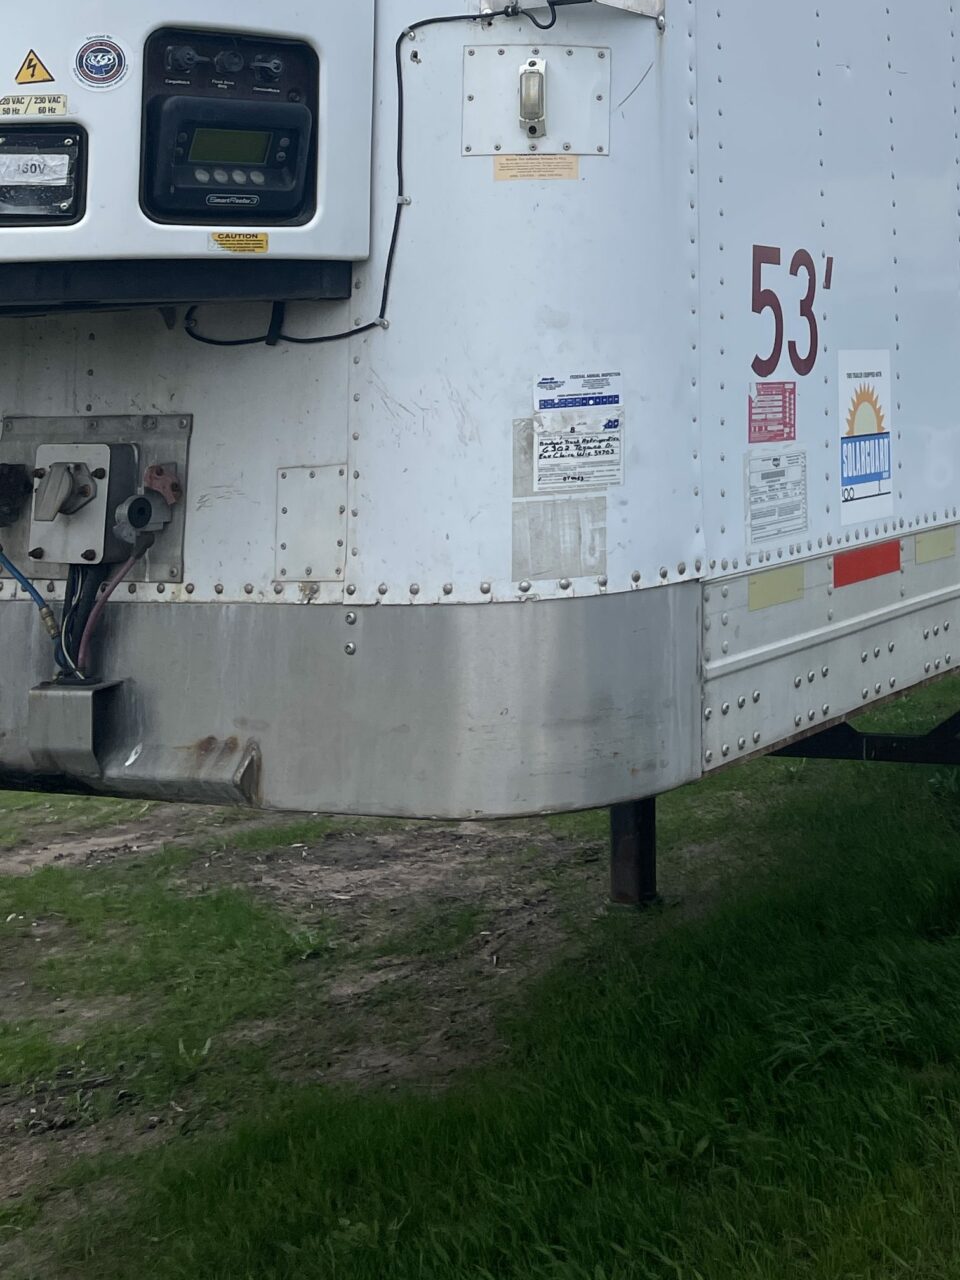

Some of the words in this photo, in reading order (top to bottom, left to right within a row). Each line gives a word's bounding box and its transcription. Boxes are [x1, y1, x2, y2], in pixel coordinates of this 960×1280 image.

[11, 97, 25, 105] VAC
[47, 96, 61, 104] VAC
[2, 107, 10, 115] 50
[12, 107, 20, 115] Hz
[48, 106, 56, 114] Hz
[842, 438, 889, 478] SOLARGUARD
